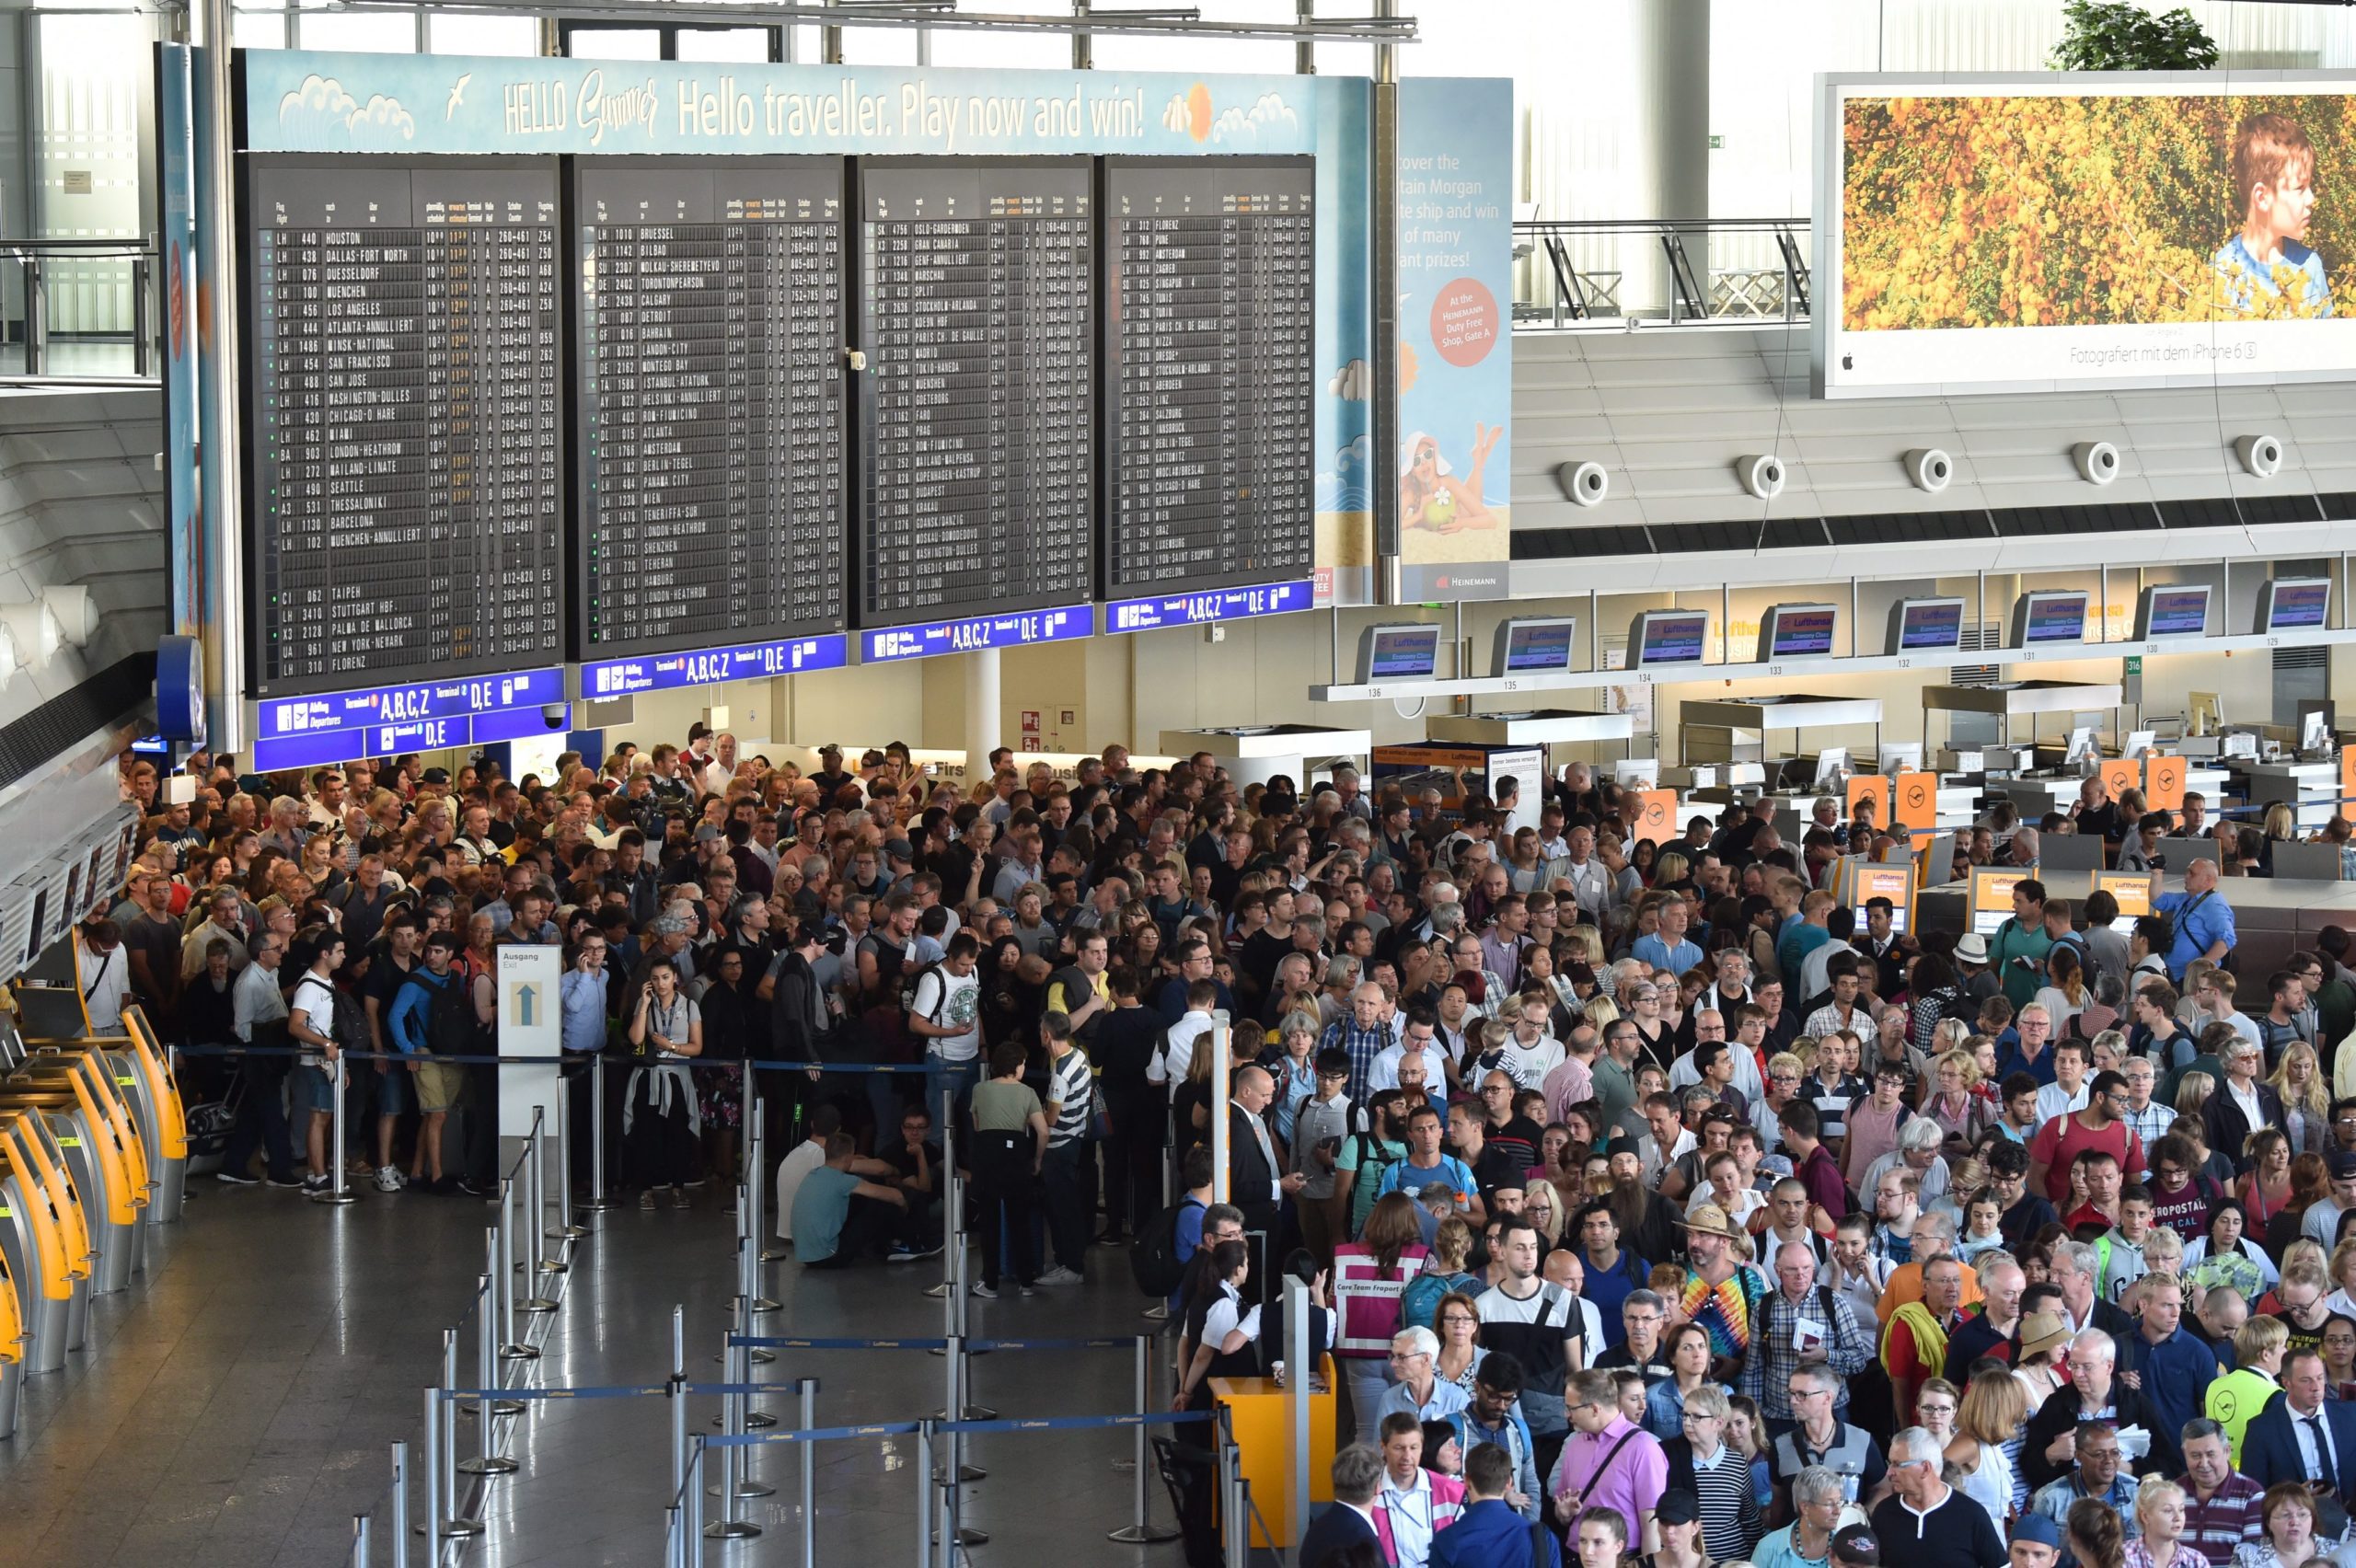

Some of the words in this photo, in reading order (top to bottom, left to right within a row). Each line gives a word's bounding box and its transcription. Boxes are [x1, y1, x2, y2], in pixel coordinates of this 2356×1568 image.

[504, 81, 566, 135] HELLO
[577, 68, 658, 147] Summer
[678, 75, 755, 135] Hello
[763, 78, 892, 136] traveller.
[901, 79, 960, 151] Play
[968, 96, 1025, 137] now
[1034, 82, 1081, 137] and
[1090, 85, 1143, 137] win!
[1438, 154, 1460, 170] the
[1430, 179, 1482, 198] Morgan
[1416, 202, 1443, 222] ship
[1447, 202, 1471, 218] and
[1475, 202, 1499, 218] win
[277, 233, 287, 245] LH
[302, 232, 317, 245] 440
[326, 232, 361, 245] HOUSTON
[499, 230, 530, 243] 260-461
[538, 230, 552, 242] Z54
[641, 226, 674, 240] BRUESSEL
[1404, 226, 1419, 243] of
[1423, 230, 1461, 247] many
[302, 250, 317, 263] 438
[326, 249, 379, 263] DALLAS-FORT
[641, 244, 666, 257] BILBAO
[1426, 250, 1471, 271] prizes!
[327, 267, 380, 281] DUESSELDORF
[915, 284, 934, 297] SPLIT
[641, 294, 671, 307] CALGARY
[1449, 297, 1460, 306] At
[1461, 294, 1472, 304] the
[327, 303, 342, 317] LOS
[346, 302, 381, 316] ANGELES
[641, 310, 672, 323] DETROIT
[1446, 322, 1464, 334] Duty
[1466, 318, 1484, 329] Free
[1442, 337, 1464, 348] Shop,
[1465, 331, 1484, 341] Gate
[1484, 328, 1491, 339] A
[2071, 346, 2138, 367] Fotografiert
[2142, 346, 2161, 361] mit
[2164, 344, 2189, 361] dem
[2192, 343, 2232, 361] iPhone
[2234, 342, 2242, 359] 6
[329, 357, 344, 370] SAN
[347, 356, 391, 369] FRANCISCO
[643, 457, 693, 472] BERLIN-TEGEL
[330, 480, 364, 494] SEATTLE
[916, 485, 945, 499] BUDAPEST
[330, 496, 387, 513] THESSALONIKI
[330, 514, 375, 530] BARCELONA
[644, 558, 674, 571] TEHERAN
[1451, 576, 1496, 587] HEINEMANN
[331, 586, 361, 600] TAIPEH
[1249, 589, 1265, 616] D,E
[2046, 604, 2083, 613] Lufthansa
[331, 603, 375, 618] STUTTGART
[644, 622, 670, 637] BEIRUT
[1021, 616, 1038, 642] D,E
[1663, 624, 1702, 633] Lufthansa
[1794, 617, 1831, 628] Lufthansa
[1393, 637, 1434, 648] Lufthansa
[2146, 644, 2158, 653] 130
[765, 646, 784, 674] D,E
[2024, 651, 2035, 661] 131
[331, 656, 366, 671] FLORENZ
[1770, 666, 1782, 675] 133
[1898, 659, 1911, 668] 132
[2128, 661, 2141, 671] 316
[1504, 681, 1517, 690] 135
[1638, 674, 1651, 683] 134
[470, 682, 492, 711] D,E
[1369, 688, 1381, 698] 136
[309, 715, 341, 730] Departures
[426, 721, 446, 745] D,E
[1451, 753, 1481, 762] Lufthansa
[171, 836, 200, 856] PUMA
[1873, 872, 1904, 881] Lufthansa
[2116, 881, 2147, 890] Lufthansa
[503, 952, 538, 962] Ausgang
[2177, 1216, 2198, 1228] CAL
[1373, 1285, 1400, 1293] Fraport
